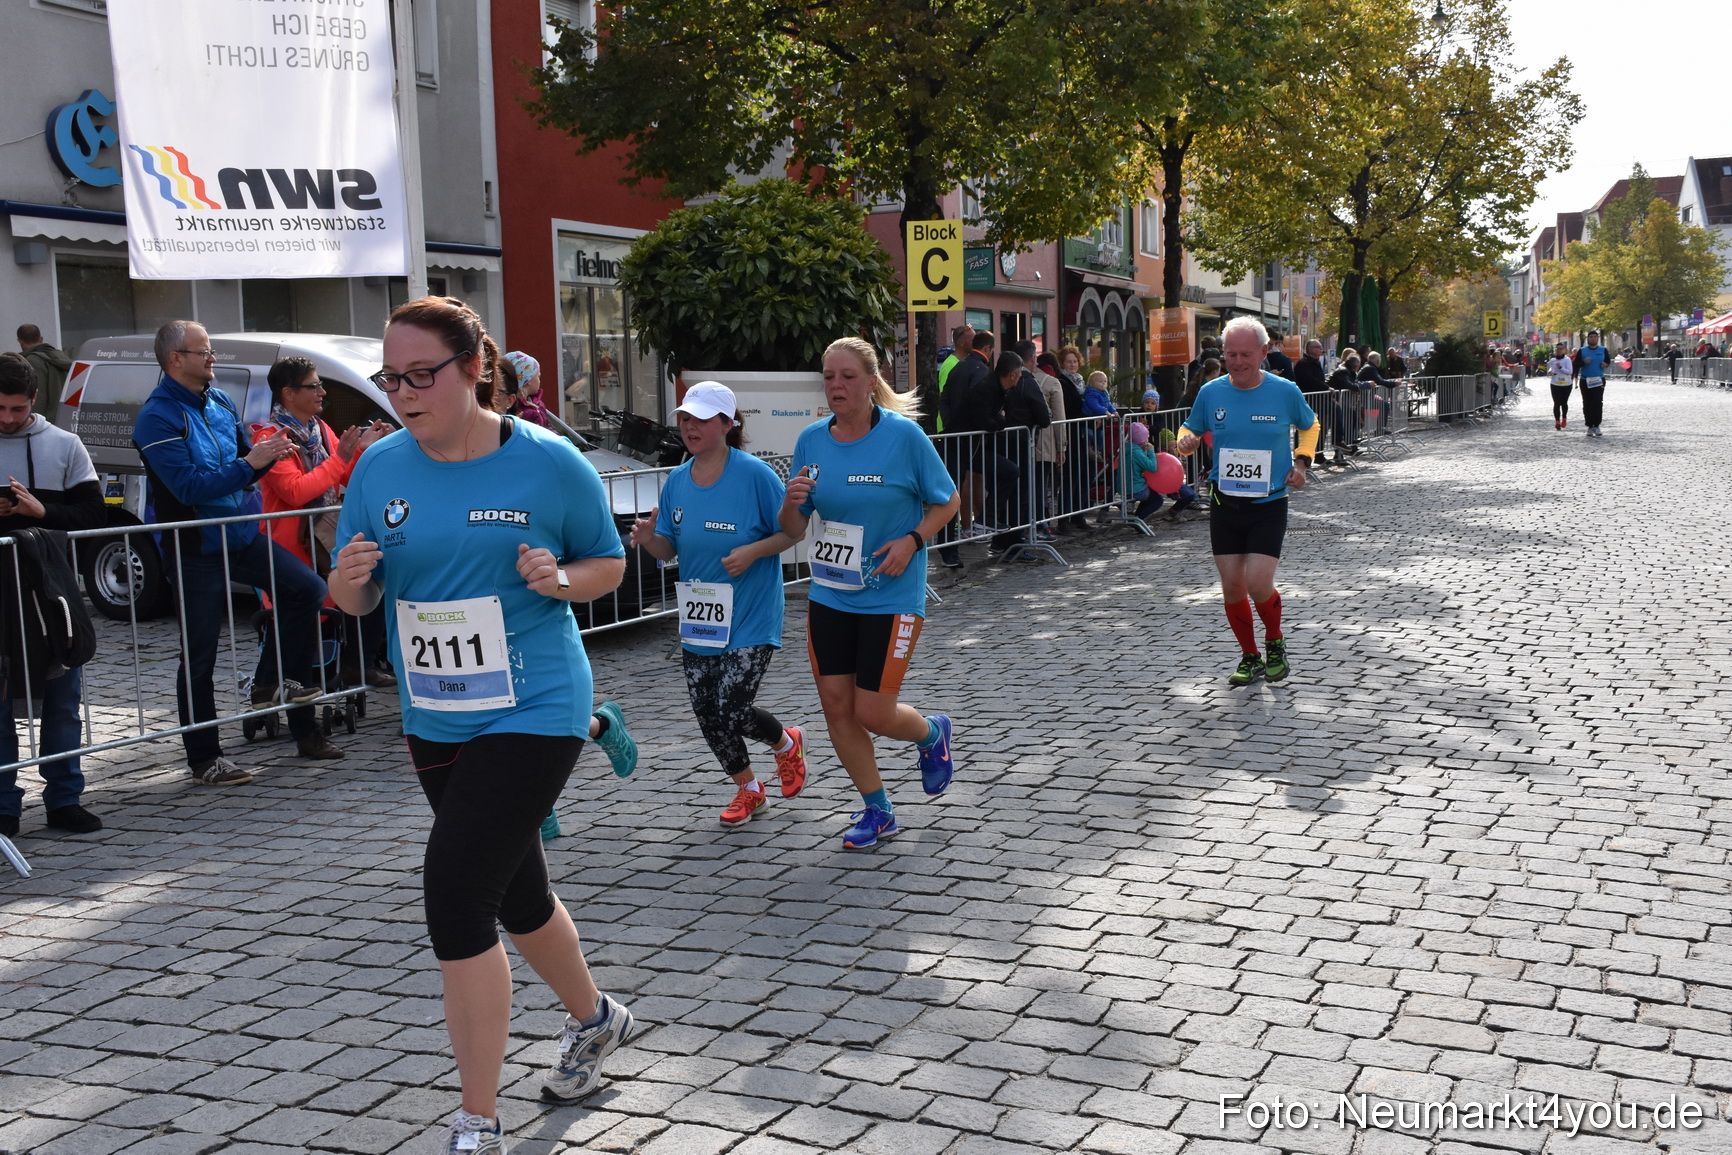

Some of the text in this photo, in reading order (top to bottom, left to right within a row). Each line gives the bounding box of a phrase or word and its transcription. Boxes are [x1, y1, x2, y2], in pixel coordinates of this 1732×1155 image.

[913, 223, 957, 241] Block
[921, 247, 950, 292] C
[969, 257, 990, 271] FASS
[1489, 318, 1498, 331] D
[97, 349, 118, 359] Energie
[120, 350, 140, 359] Wasser
[86, 412, 103, 422] IHRE
[103, 412, 131, 423] STROM-
[771, 409, 804, 417] Diakonie
[70, 423, 117, 435] VERSORGUNG
[1226, 463, 1262, 479] 2354
[847, 475, 883, 483] BOCK
[469, 510, 529, 524] BOCK
[704, 521, 737, 531] BOCK
[815, 540, 854, 566] 2277
[825, 568, 844, 579] Sabine
[427, 611, 466, 622] BOCK
[686, 600, 725, 623] 2278
[691, 627, 718, 636] Stephanie
[411, 633, 485, 669] 2111
[439, 680, 467, 692] Dana
